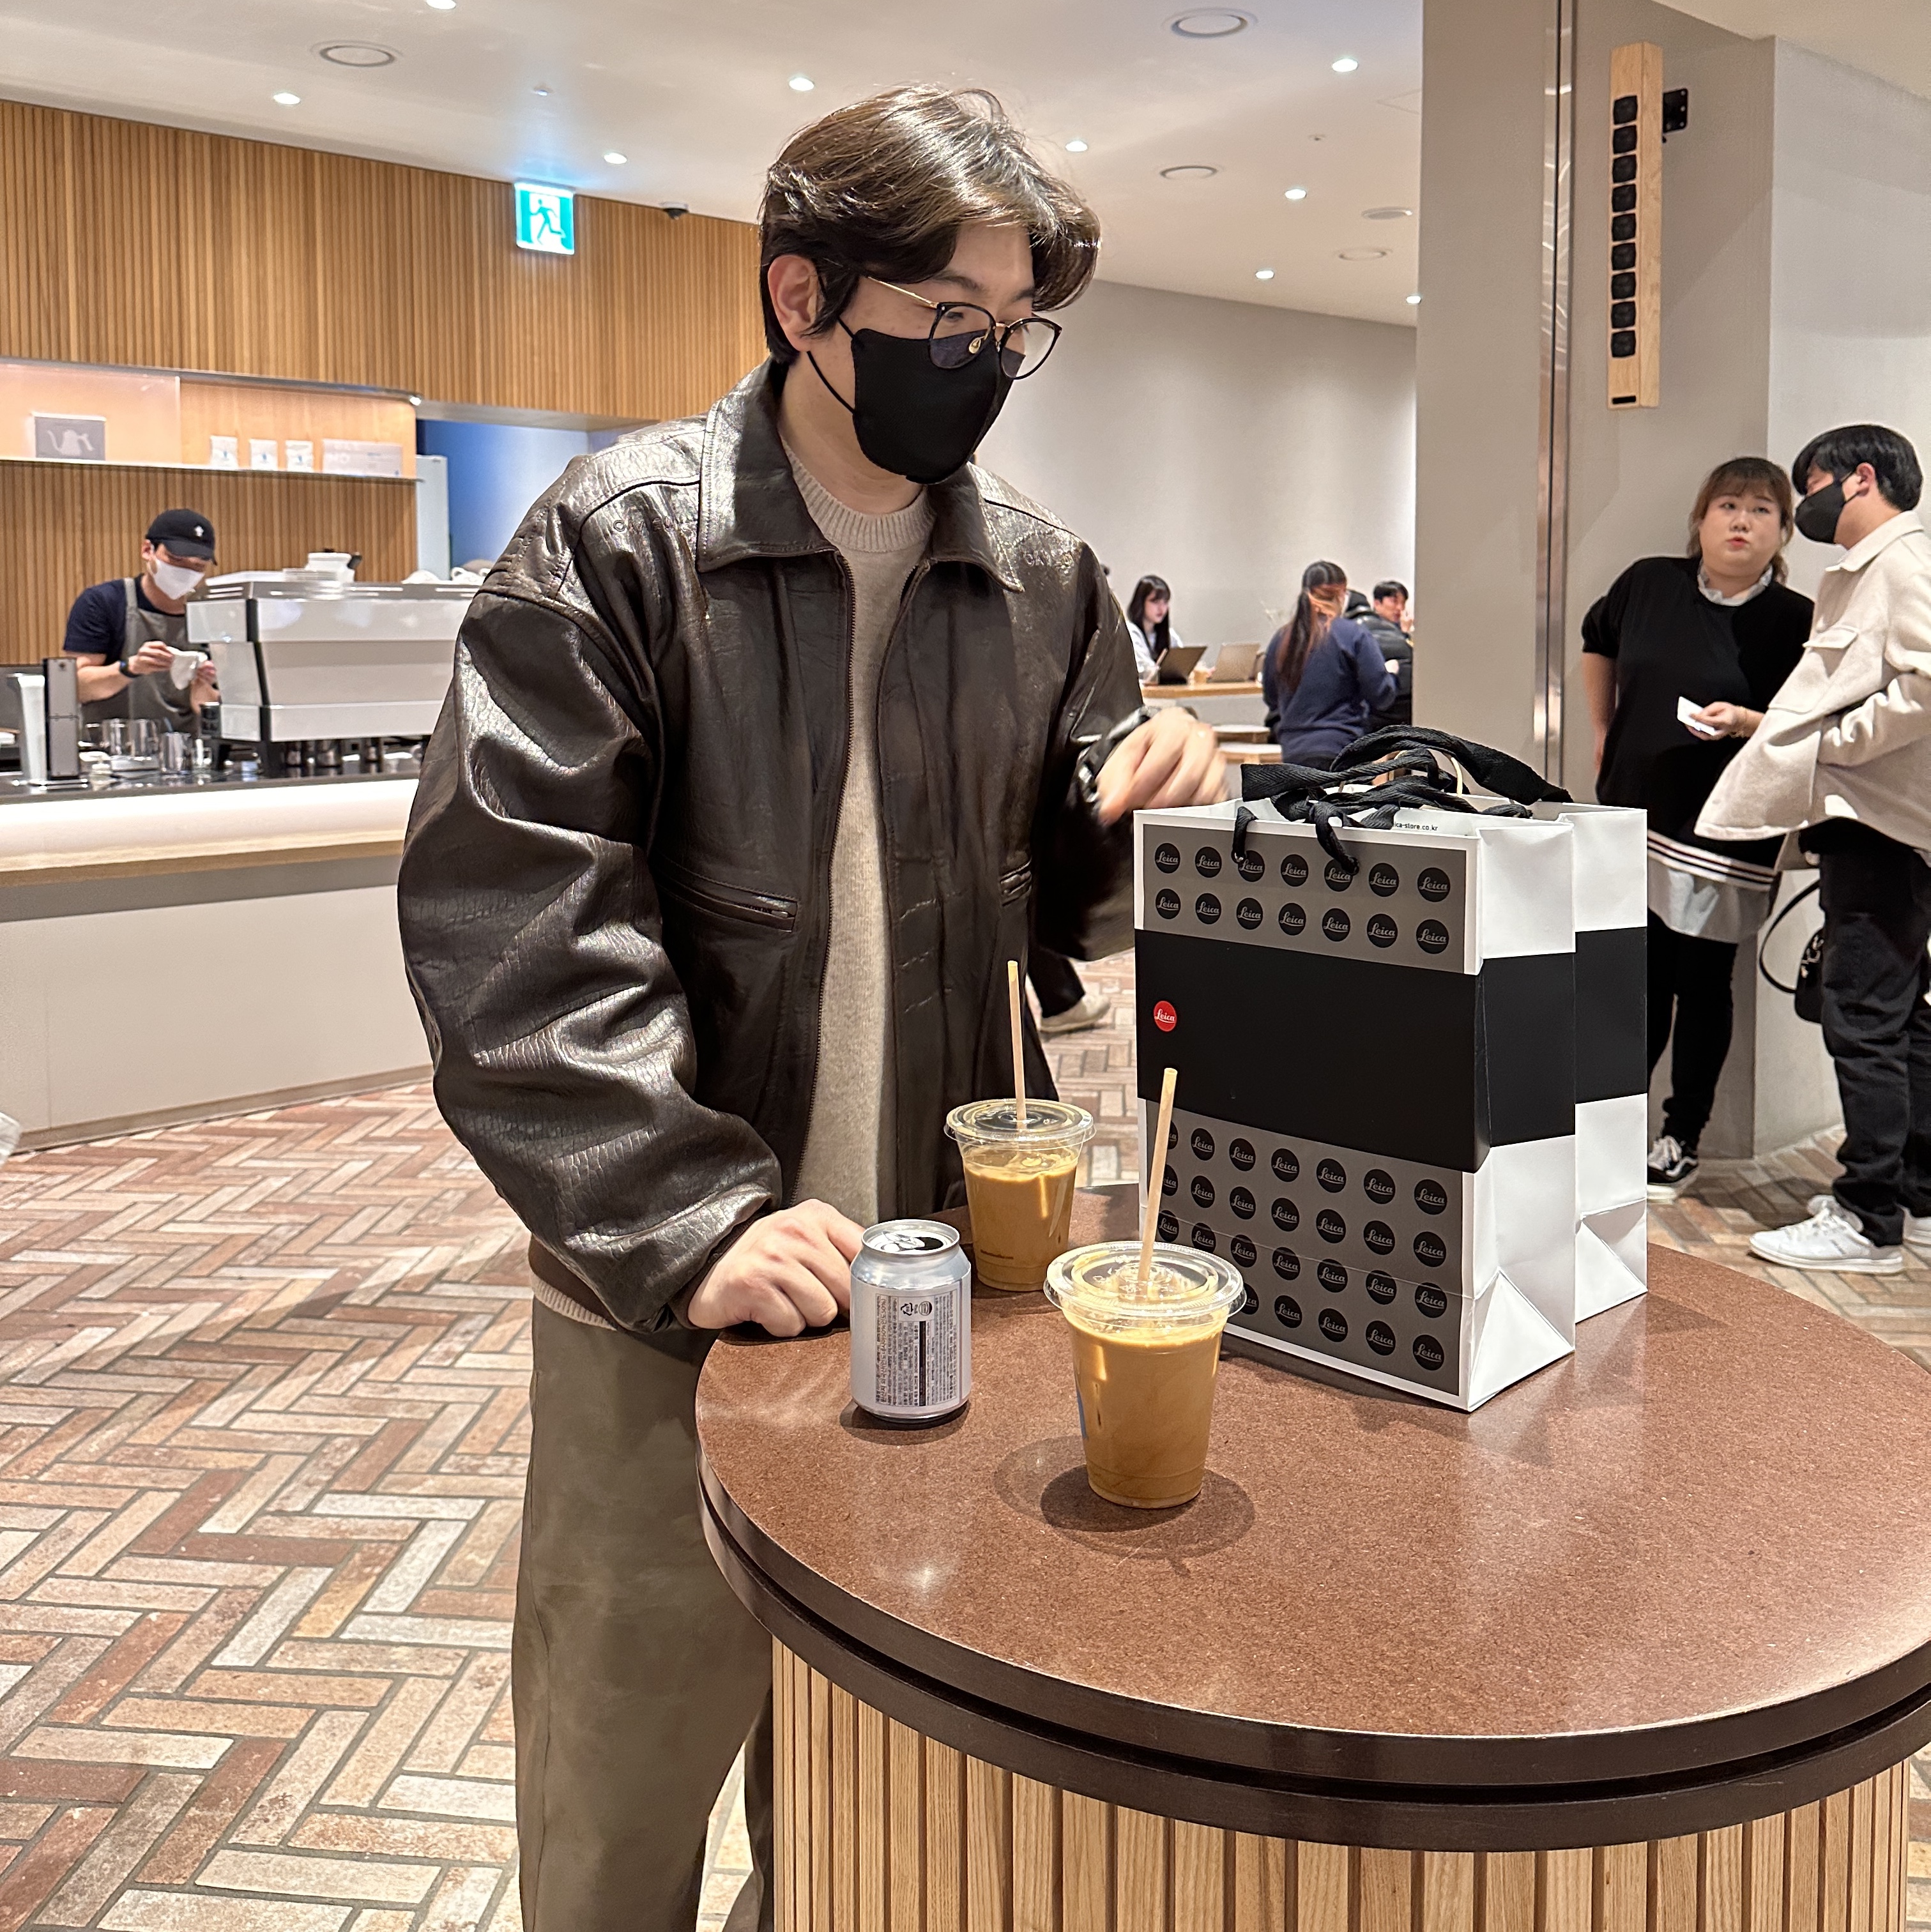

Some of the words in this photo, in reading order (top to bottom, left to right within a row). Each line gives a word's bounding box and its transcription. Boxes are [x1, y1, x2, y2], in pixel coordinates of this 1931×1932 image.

[1157, 851, 1178, 865] Leica
[1196, 855, 1219, 869] Leica
[1239, 859, 1263, 874] Leica
[1282, 863, 1307, 878] Leica
[1325, 867, 1350, 883] Leica
[1371, 871, 1397, 887] Leica
[1419, 876, 1448, 893] Leica
[1157, 897, 1179, 910] Leica
[1197, 902, 1219, 915] Leica
[1238, 907, 1261, 920] Leica
[1280, 912, 1303, 926] Leica
[1323, 916, 1349, 932] Leica
[1368, 922, 1396, 939] Leica
[1418, 927, 1447, 945] Leica
[1154, 1007, 1175, 1023] Leica
[1193, 1136, 1213, 1152] Leica
[1231, 1146, 1254, 1162] Leica
[1272, 1156, 1298, 1173] Leica
[1318, 1166, 1345, 1184] Leica
[1193, 1183, 1213, 1200] Leica
[1365, 1176, 1393, 1195] Leica
[1231, 1194, 1255, 1211] Leica
[1416, 1187, 1445, 1206] Leica
[1273, 1206, 1298, 1223] Leica
[1159, 1218, 1178, 1234] Leica
[1318, 1217, 1345, 1235] Leica
[1193, 1230, 1214, 1247] Leica
[1365, 1228, 1394, 1246] Leica
[1232, 1242, 1255, 1259] Leica
[1415, 1240, 1444, 1259] Leica
[1274, 1255, 1299, 1272] Leica
[1319, 1265, 1346, 1284] Leica
[1367, 1277, 1394, 1297] Leica
[1416, 1289, 1445, 1309] Leica
[1276, 1303, 1301, 1321] Leica
[1320, 1316, 1347, 1335] Leica
[1367, 1328, 1394, 1348] Leica
[1414, 1342, 1442, 1362] Leica
